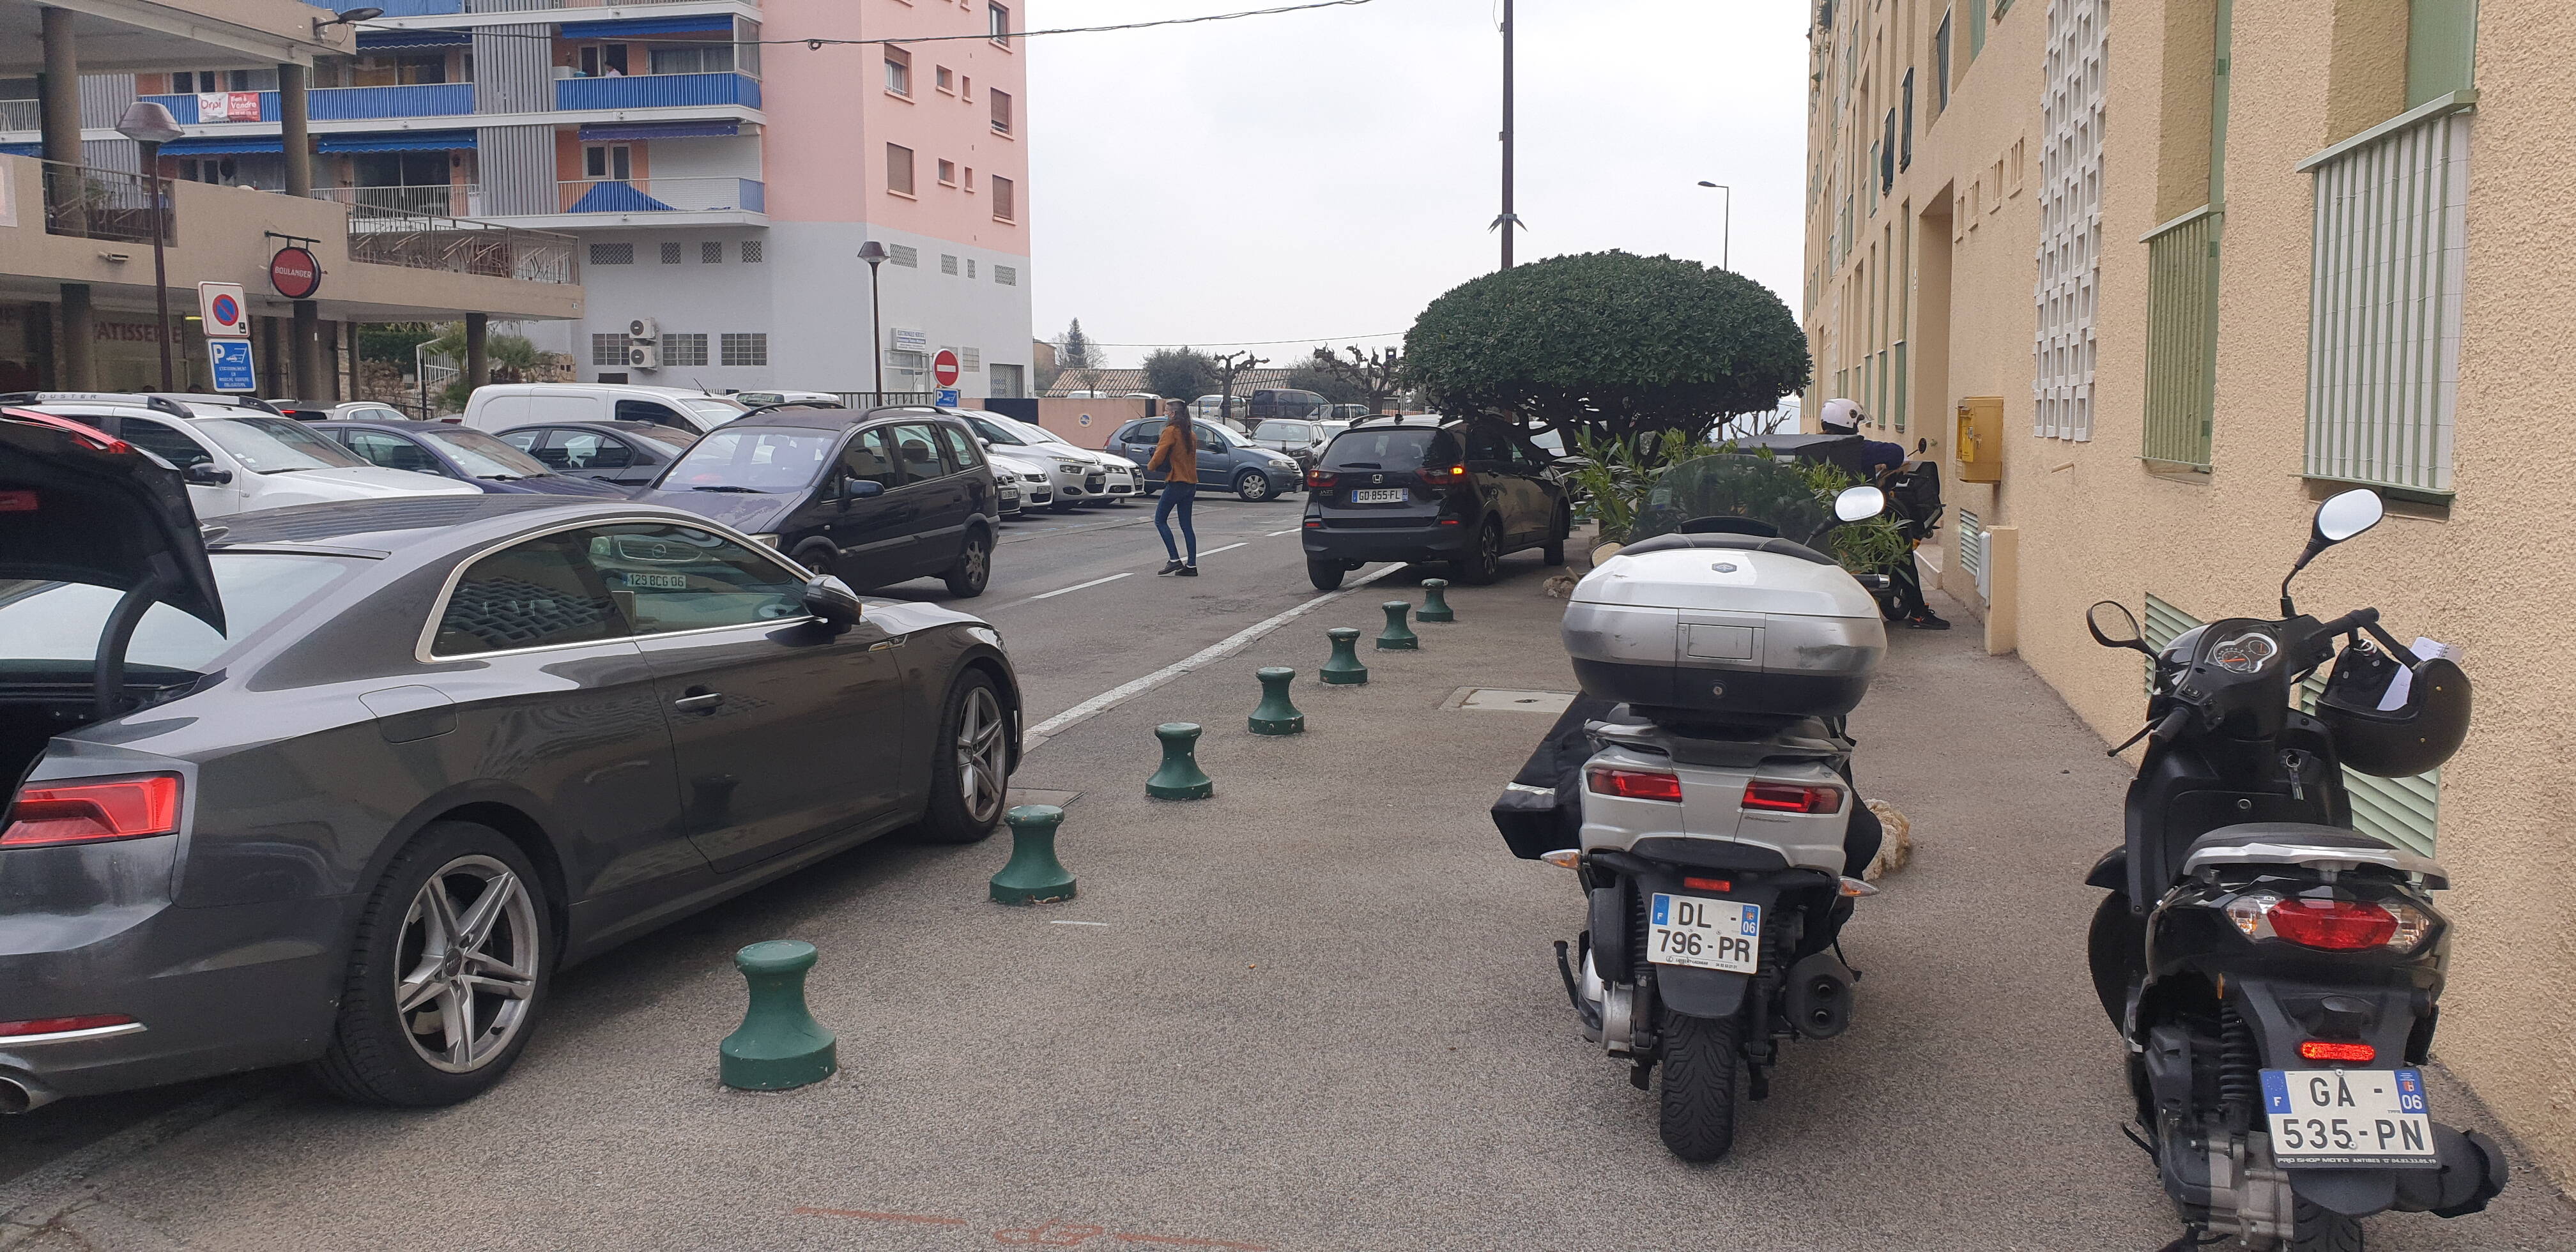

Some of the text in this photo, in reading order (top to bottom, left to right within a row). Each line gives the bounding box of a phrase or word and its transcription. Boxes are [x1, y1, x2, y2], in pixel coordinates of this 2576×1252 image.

[201, 98, 221, 111] Orpi
[275, 266, 311, 279] BOULANGER
[94, 321, 181, 344] ATISSEE
[213, 344, 225, 364] P
[937, 391, 944, 402] P
[1359, 490, 1400, 500] GD-855-FL
[631, 574, 647, 585] 129
[671, 576, 684, 586] 06
[1678, 901, 1712, 928] DL
[1743, 921, 1756, 934] 06
[1657, 929, 1750, 963] 796-PR
[2310, 1077, 2356, 1107] GA
[2402, 1094, 2423, 1110] 06
[2283, 1118, 2425, 1150] 535-PN
